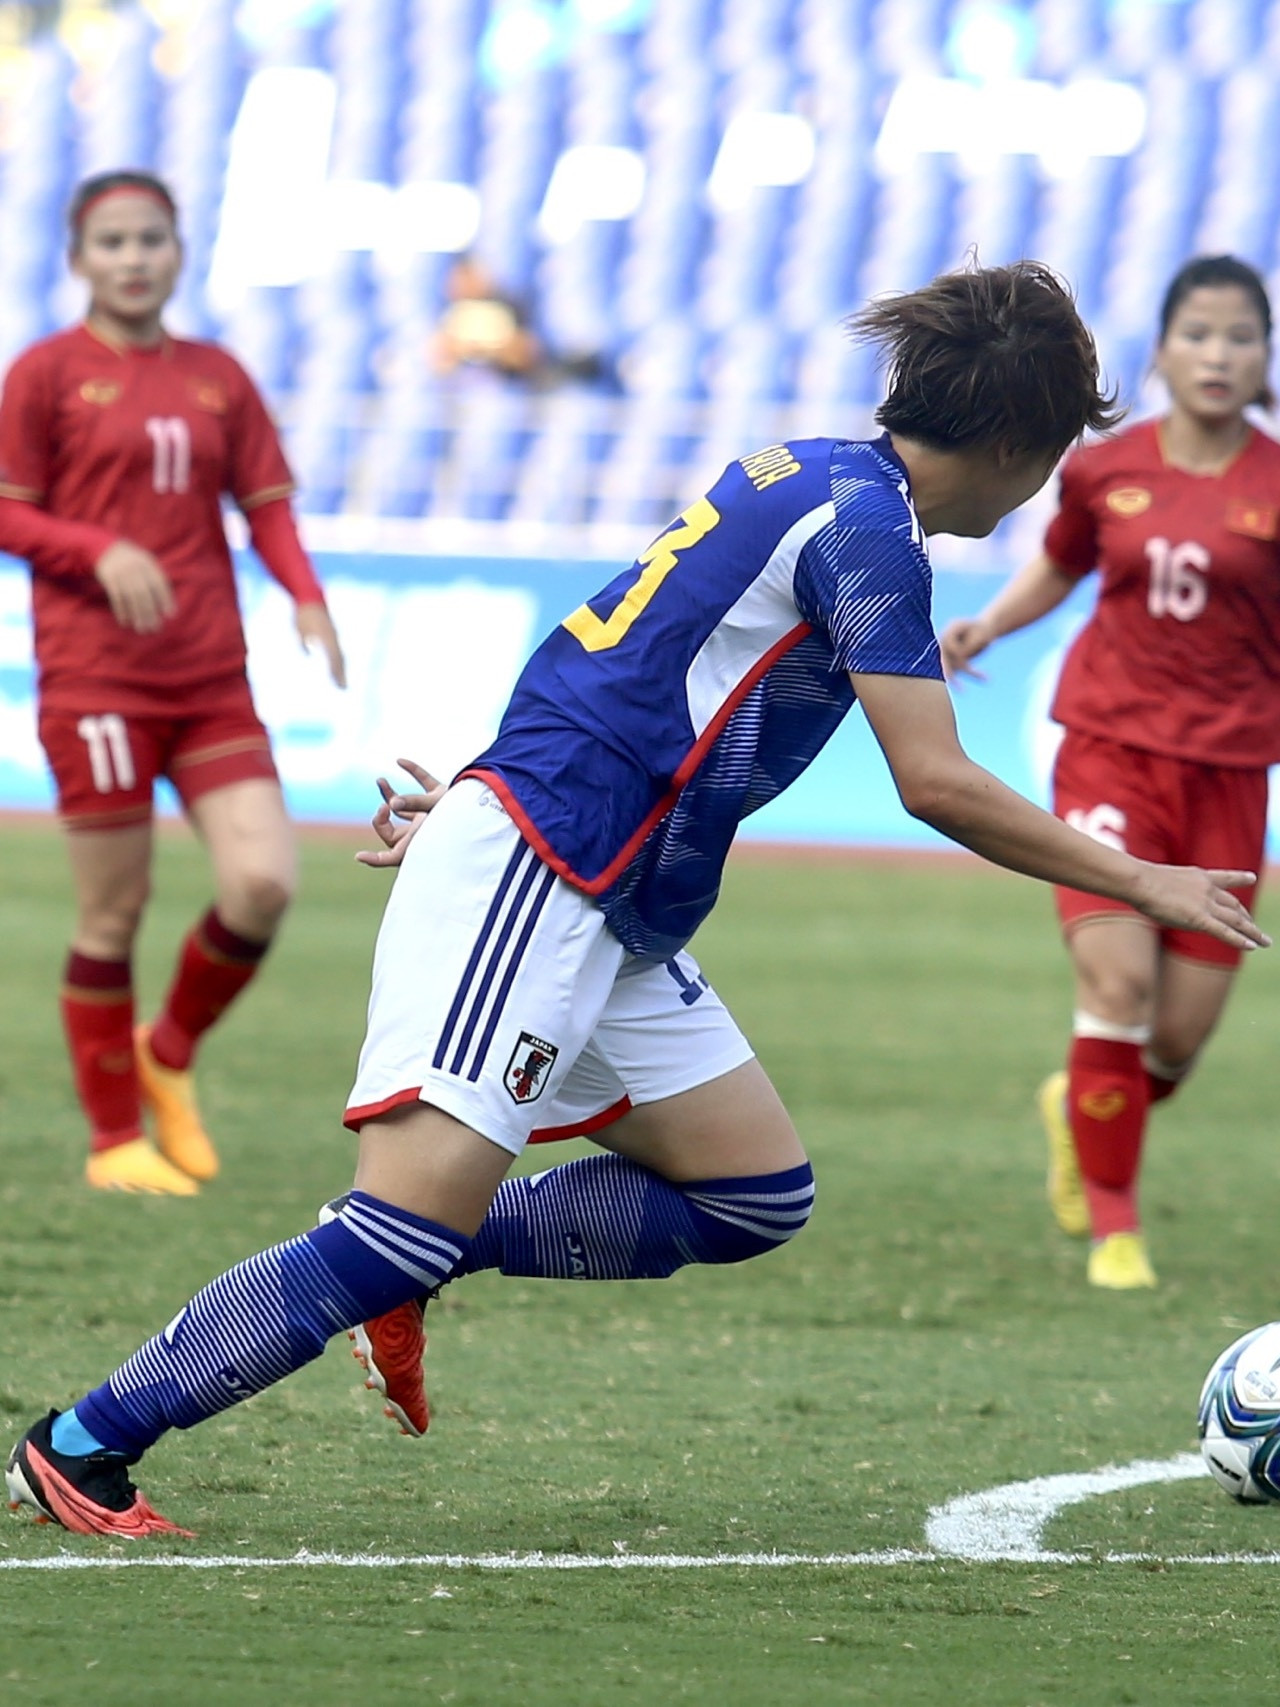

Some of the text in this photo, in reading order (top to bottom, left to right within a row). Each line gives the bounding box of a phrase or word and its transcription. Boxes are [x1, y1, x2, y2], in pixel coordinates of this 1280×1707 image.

[144, 415, 192, 494] 11
[1144, 536, 1211, 621] 16
[77, 713, 136, 794] 11
[529, 1037, 553, 1053] JAPAN
